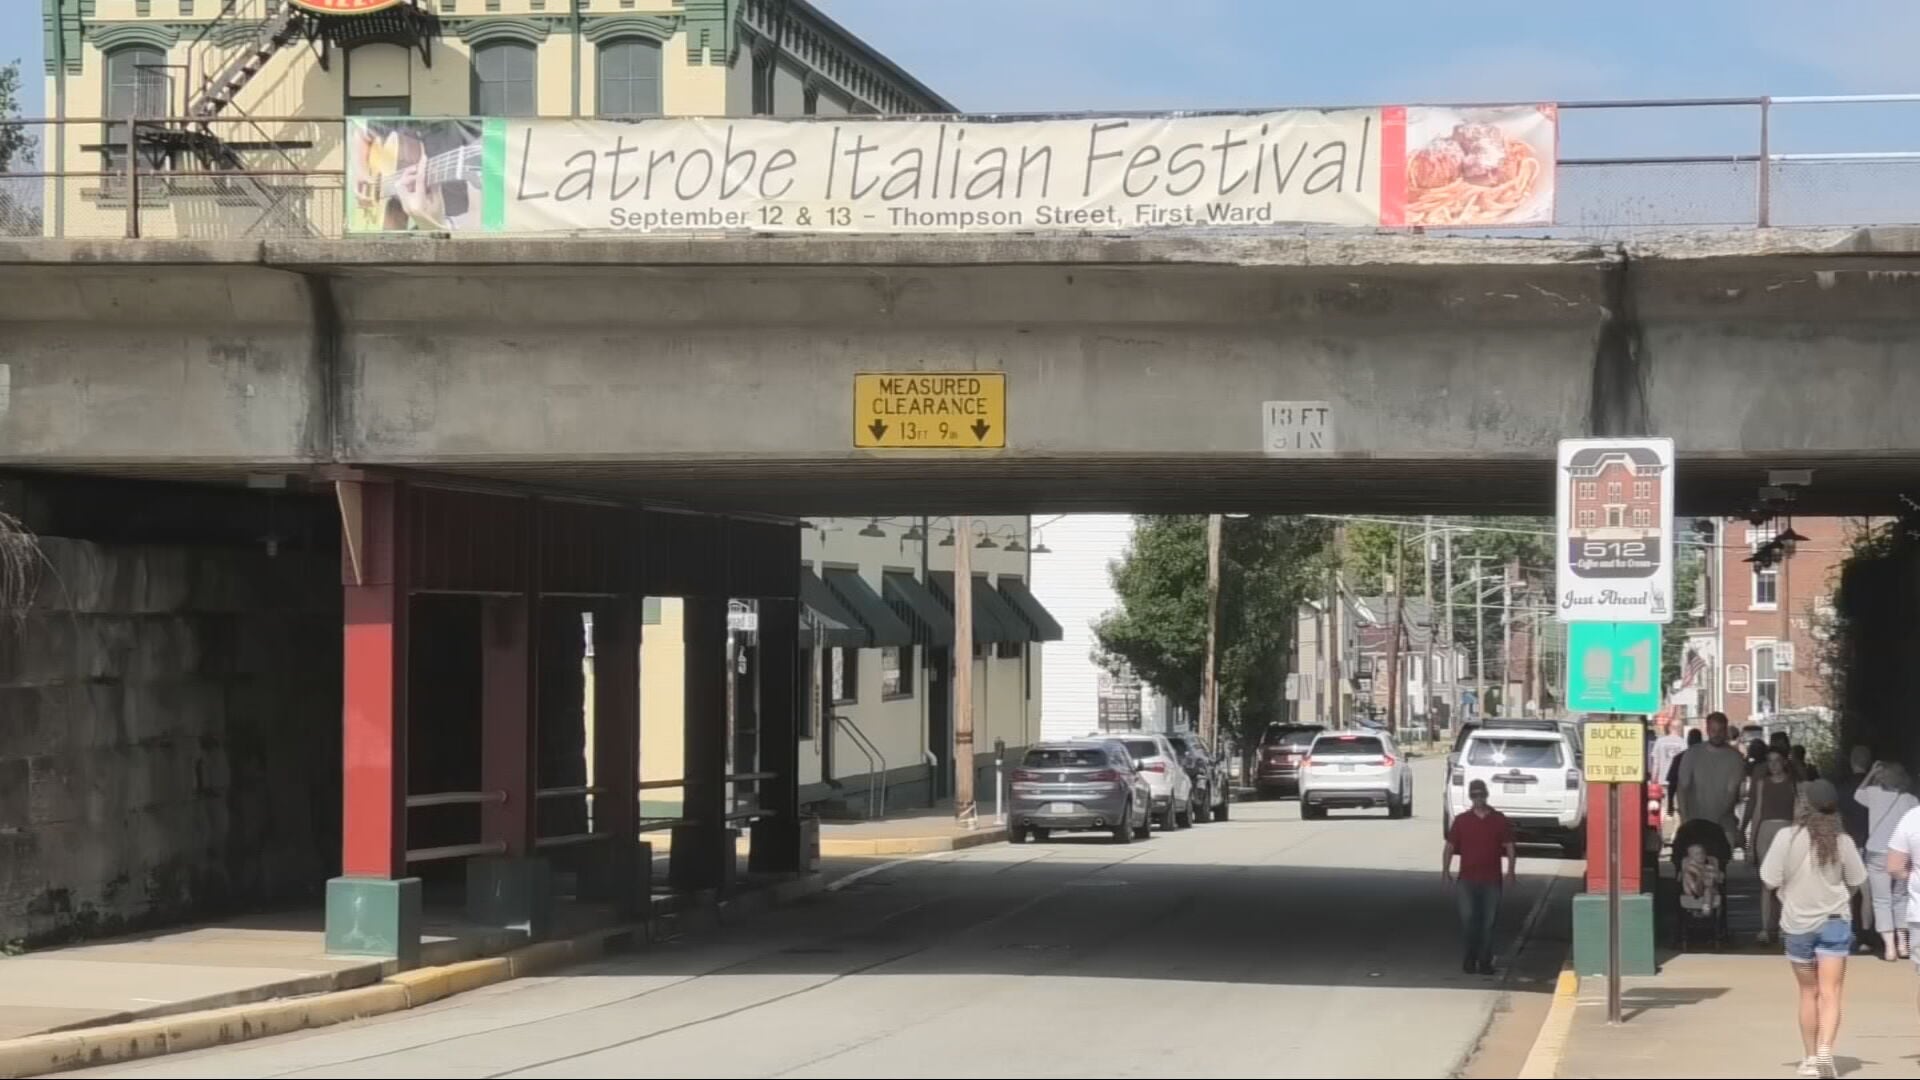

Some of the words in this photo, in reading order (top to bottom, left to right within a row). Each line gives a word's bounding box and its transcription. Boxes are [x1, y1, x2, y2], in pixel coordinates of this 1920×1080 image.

[516, 125, 797, 201] Latrobe
[825, 124, 1051, 201] Italian
[1083, 117, 1371, 198] Festival
[609, 207, 749, 231] September
[758, 206, 783, 225] 12
[796, 207, 812, 226] &
[826, 207, 851, 226] 13
[888, 207, 1022, 230] Thompson
[1035, 205, 1123, 227] Street,
[1135, 204, 1193, 223] First
[1206, 202, 1272, 222] Ward
[879, 378, 981, 396] MEASURED
[872, 398, 988, 415] CLEARANCE
[1302, 408, 1328, 426] FT
[1583, 542, 1646, 557] 512
[1562, 590, 1593, 609] Just
[1597, 589, 1648, 605] Ahead
[1591, 728, 1636, 739] BUCKLE
[1605, 745, 1621, 759] UP
